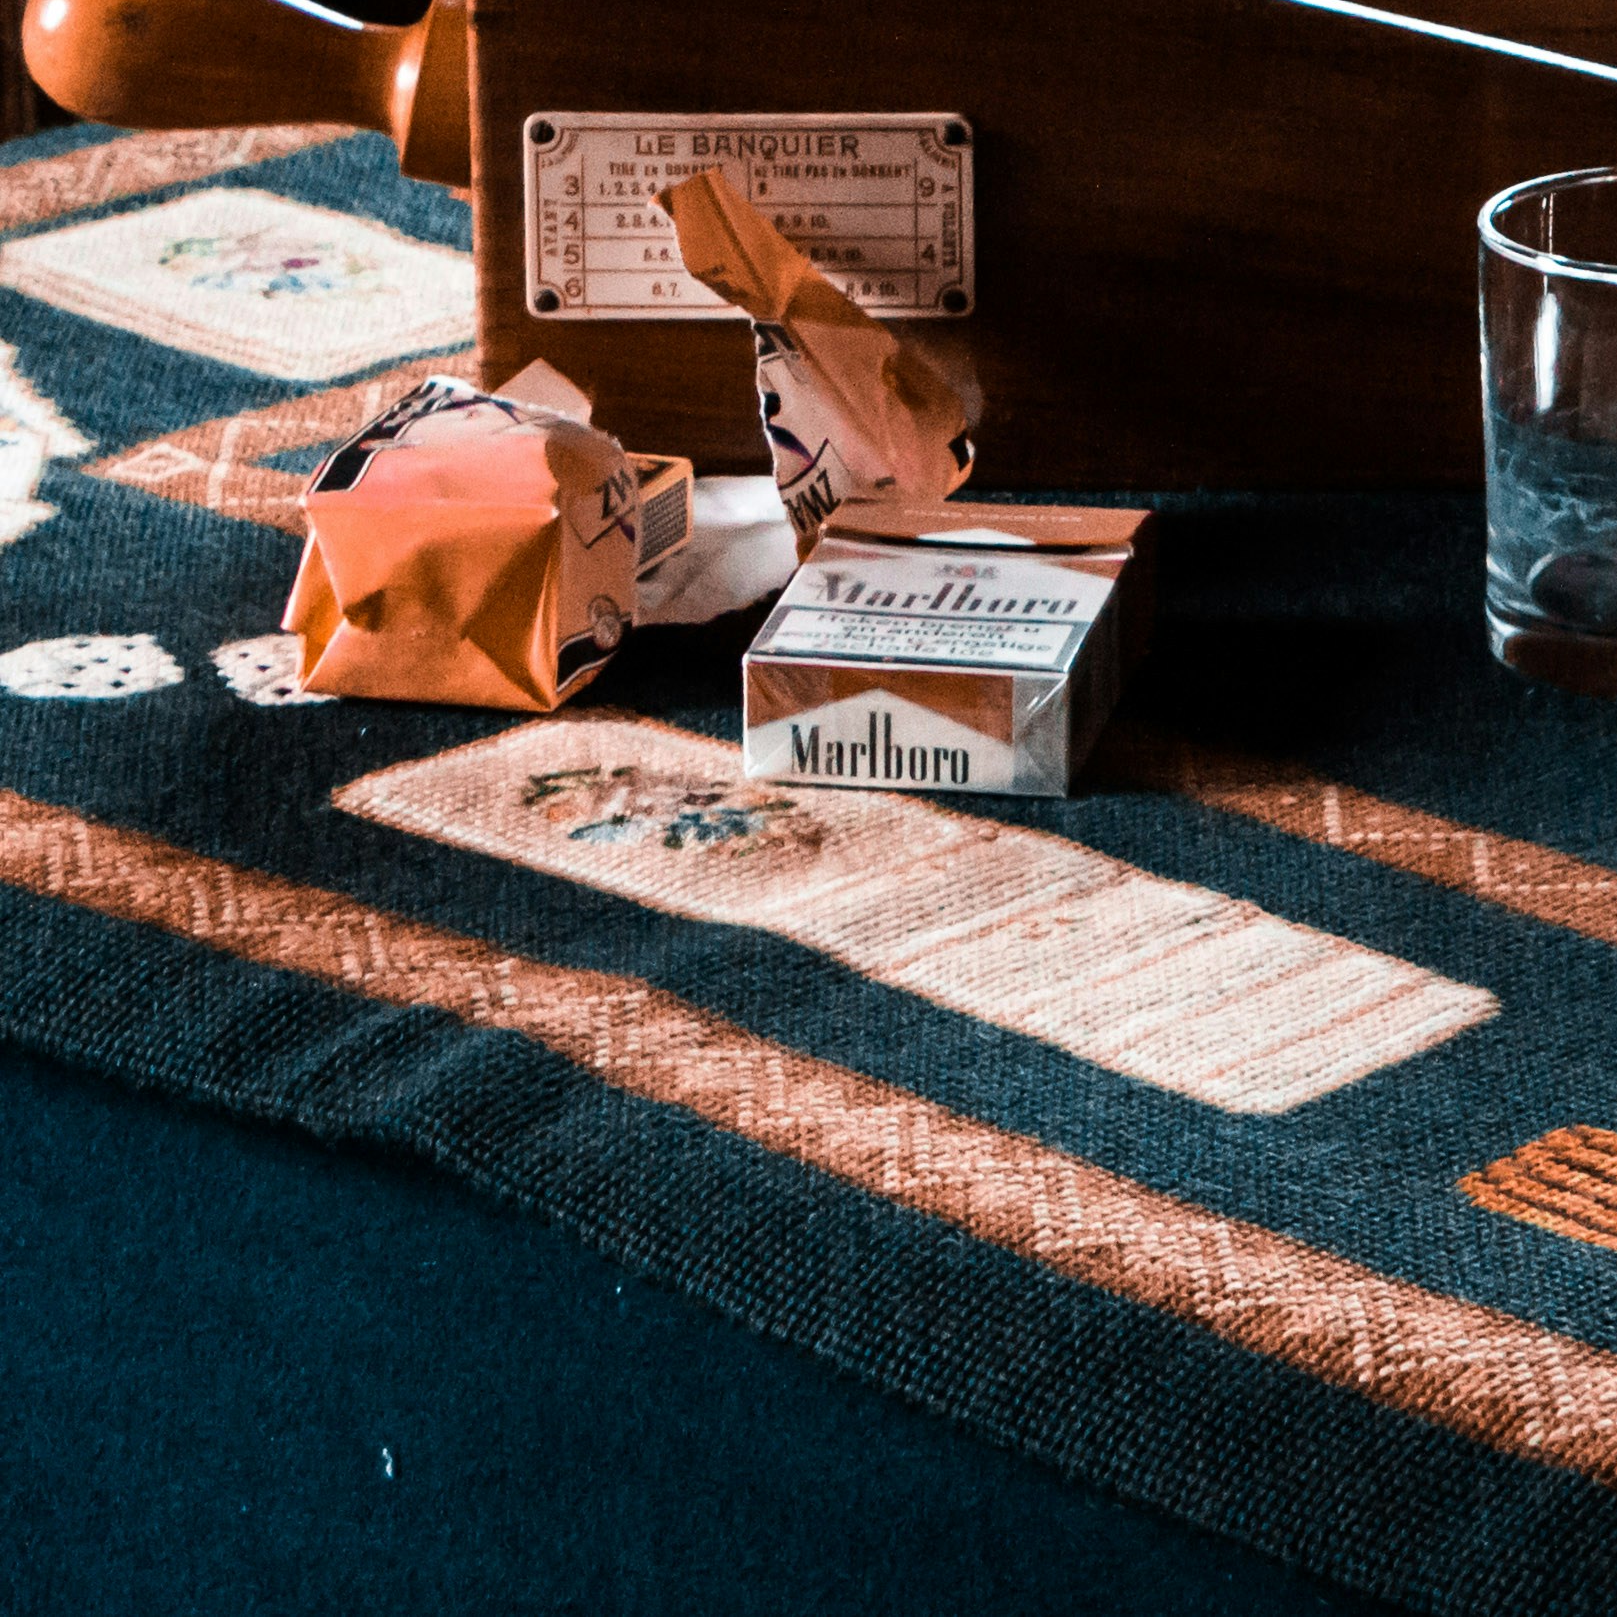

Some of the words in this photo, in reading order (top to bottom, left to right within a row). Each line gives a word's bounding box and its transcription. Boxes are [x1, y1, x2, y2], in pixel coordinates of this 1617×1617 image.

[634, 134, 675, 156] LE
[692, 133, 860, 161] BANQUIER
[563, 174, 580, 197] 3
[918, 176, 936, 198] 9
[563, 210, 579, 231] 4
[562, 243, 581, 265] 5
[921, 242, 936, 263] 4
[564, 276, 582, 298] 6
[808, 570, 1079, 615] Marlboro
[790, 710, 970, 785] Marlboro
